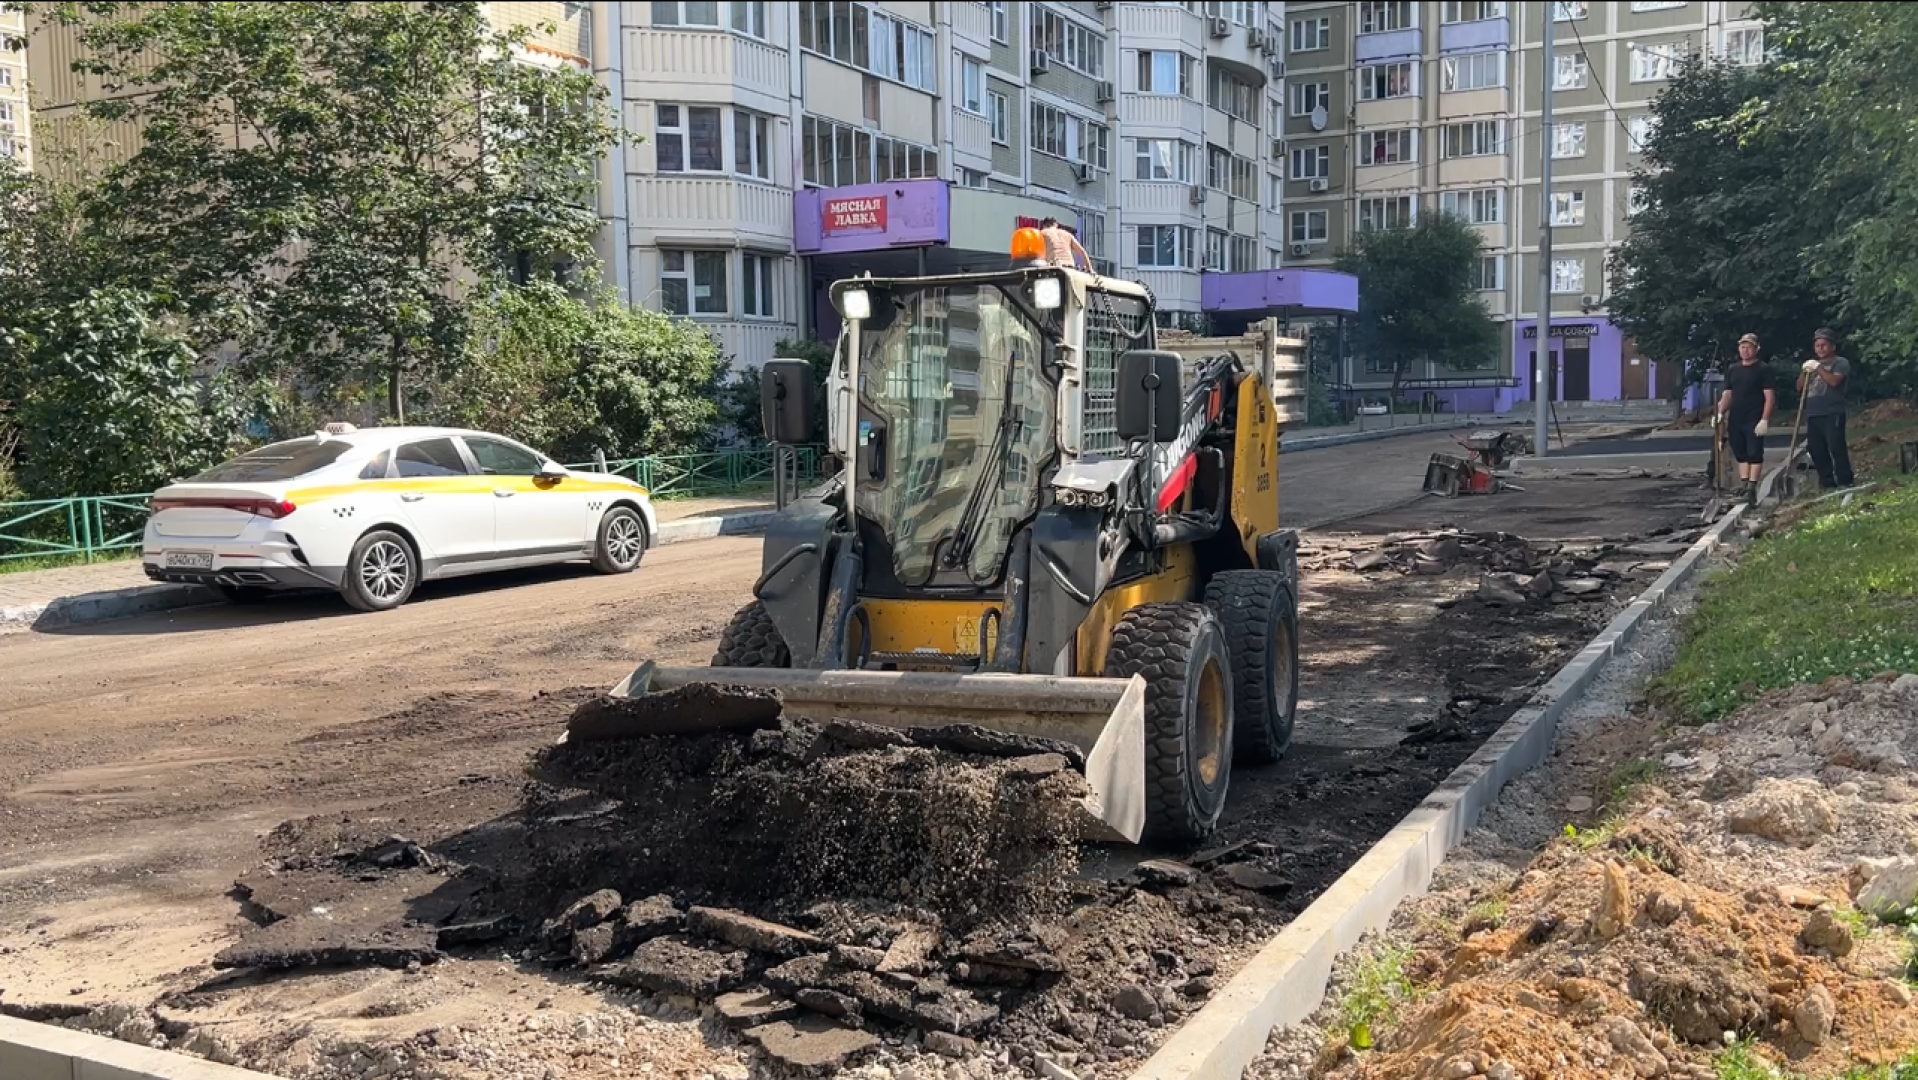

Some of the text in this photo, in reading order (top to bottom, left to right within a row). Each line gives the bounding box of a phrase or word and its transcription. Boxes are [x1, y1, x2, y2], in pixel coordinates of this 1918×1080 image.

[830, 199, 881, 214] МЯСНАЯ
[834, 211, 877, 226] ЛАВКА
[1550, 327, 1563, 337] ЗА
[1564, 324, 1598, 336] СОБОЙ
[1260, 443, 1266, 468] 2
